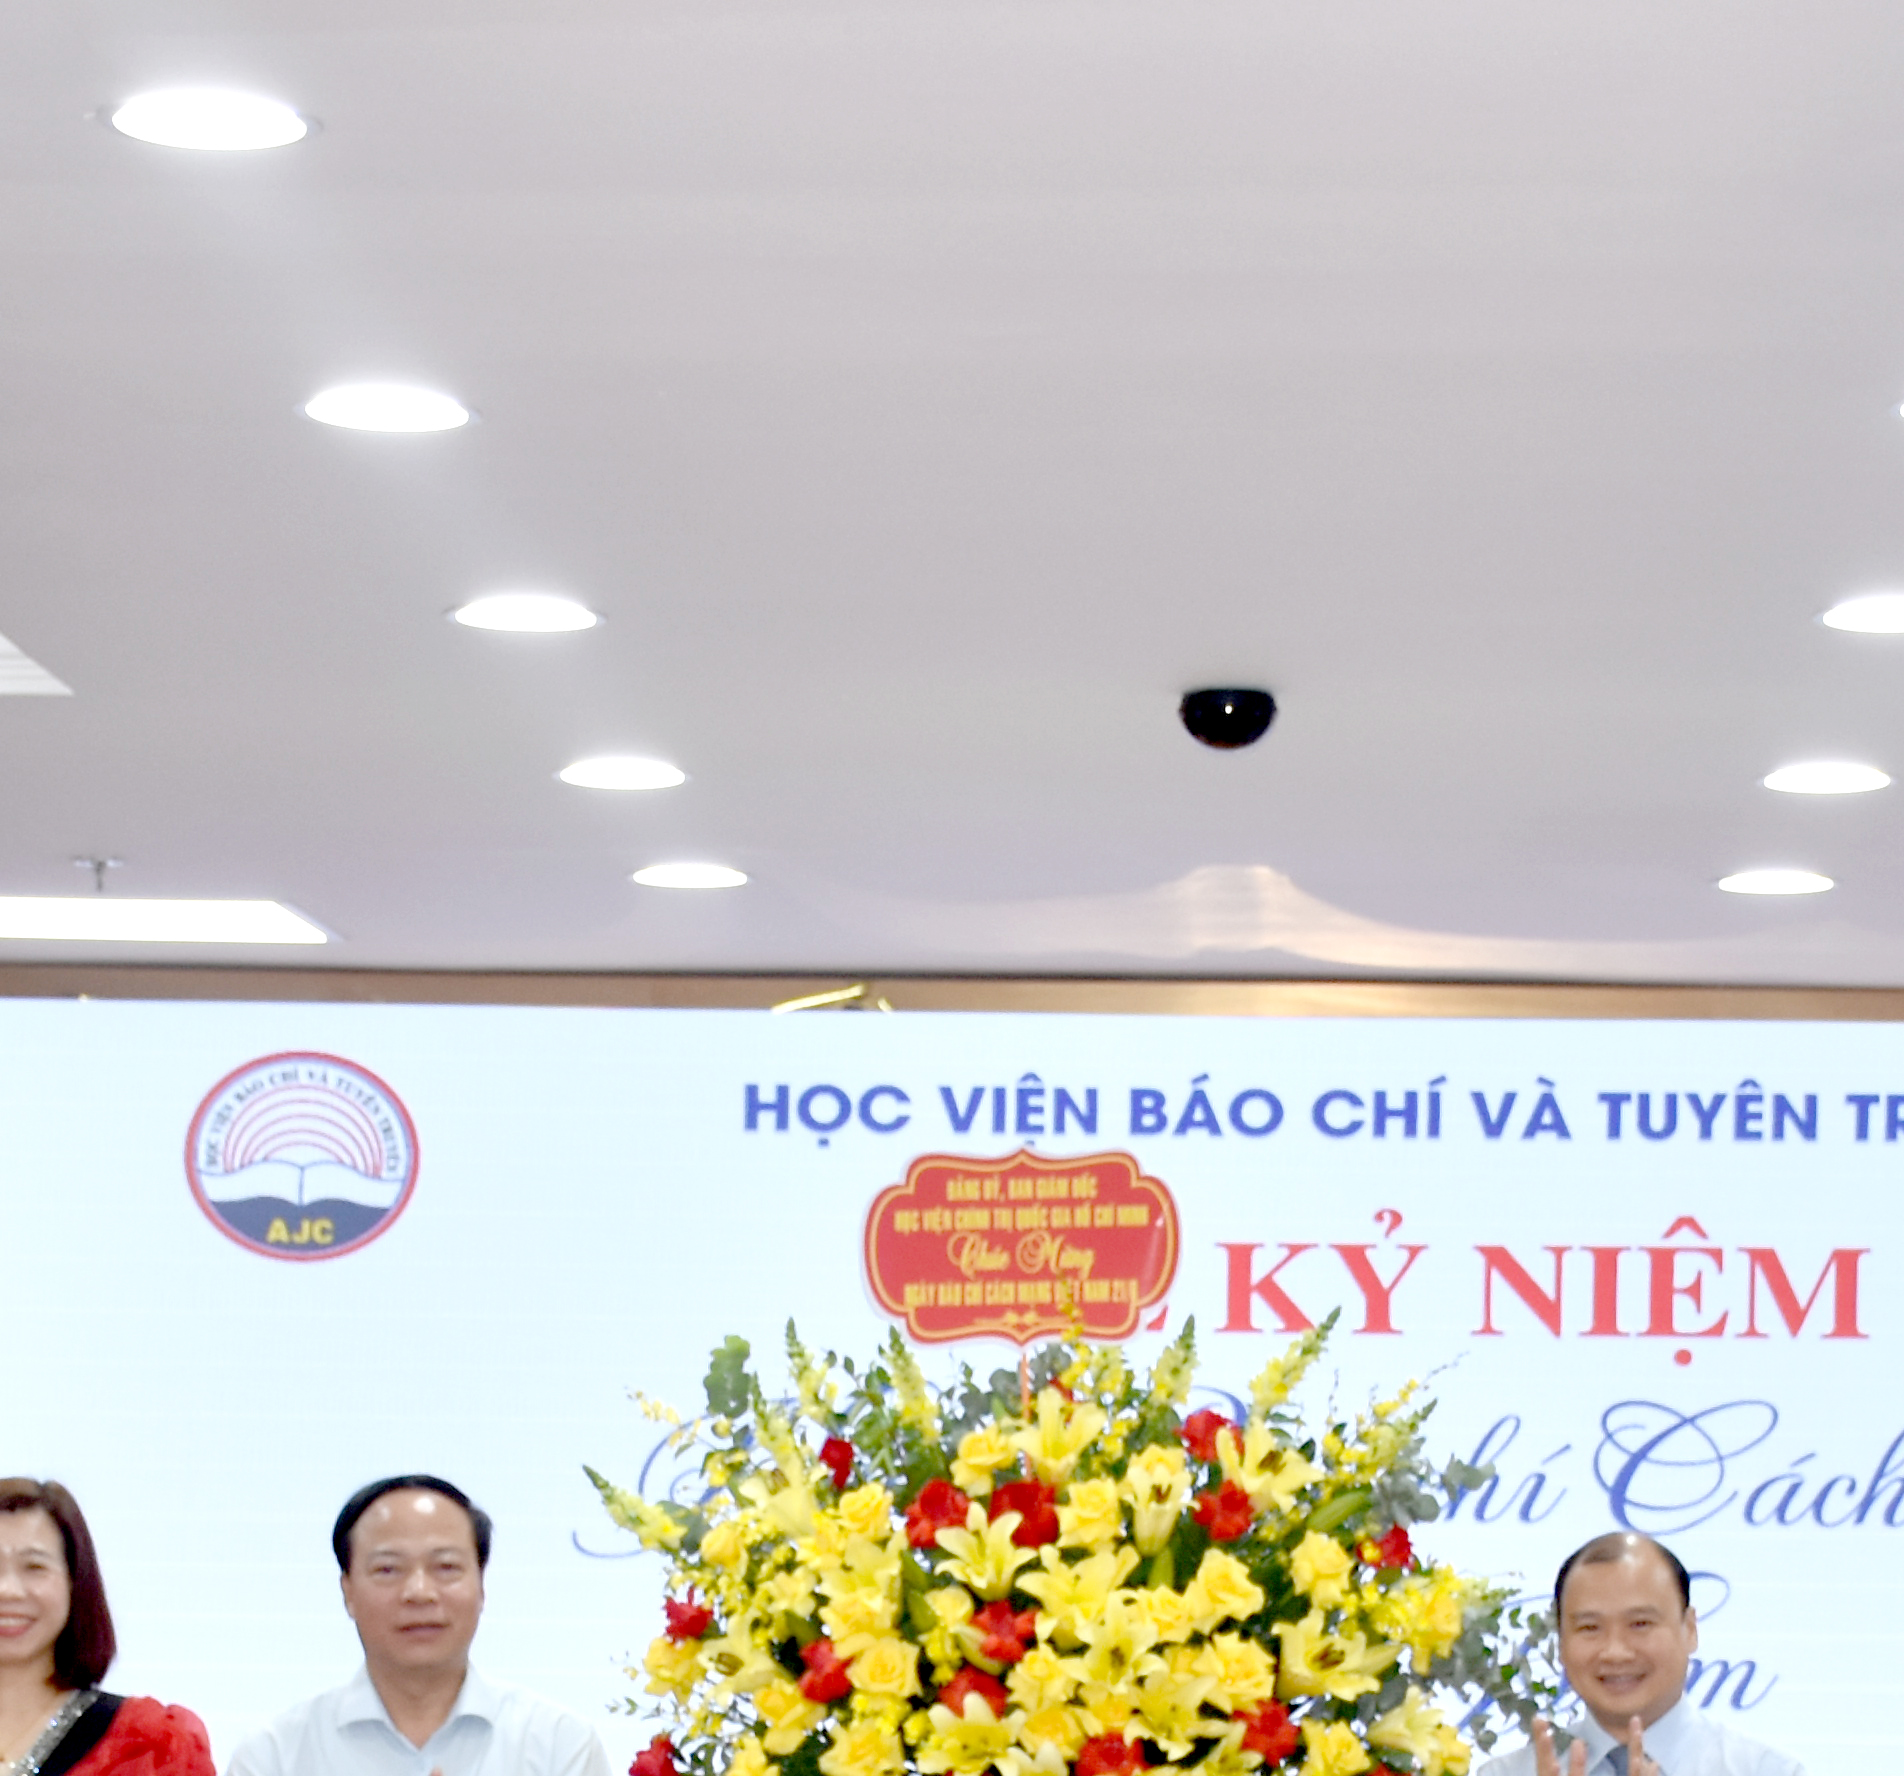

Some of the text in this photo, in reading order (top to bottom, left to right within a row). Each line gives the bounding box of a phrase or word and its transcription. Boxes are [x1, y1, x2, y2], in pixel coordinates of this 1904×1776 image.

[744, 1083, 911, 1148] HỌC
[938, 1071, 1099, 1147] VIỆN
[1128, 1073, 1285, 1139] BÁO
[1310, 1074, 1448, 1140] CHÍ
[1469, 1076, 1573, 1141] VÀ
[1596, 1077, 1819, 1143] TUYÊN
[266, 1217, 335, 1245] AJC
[1214, 1208, 1872, 1367] KỶ NIỆM
